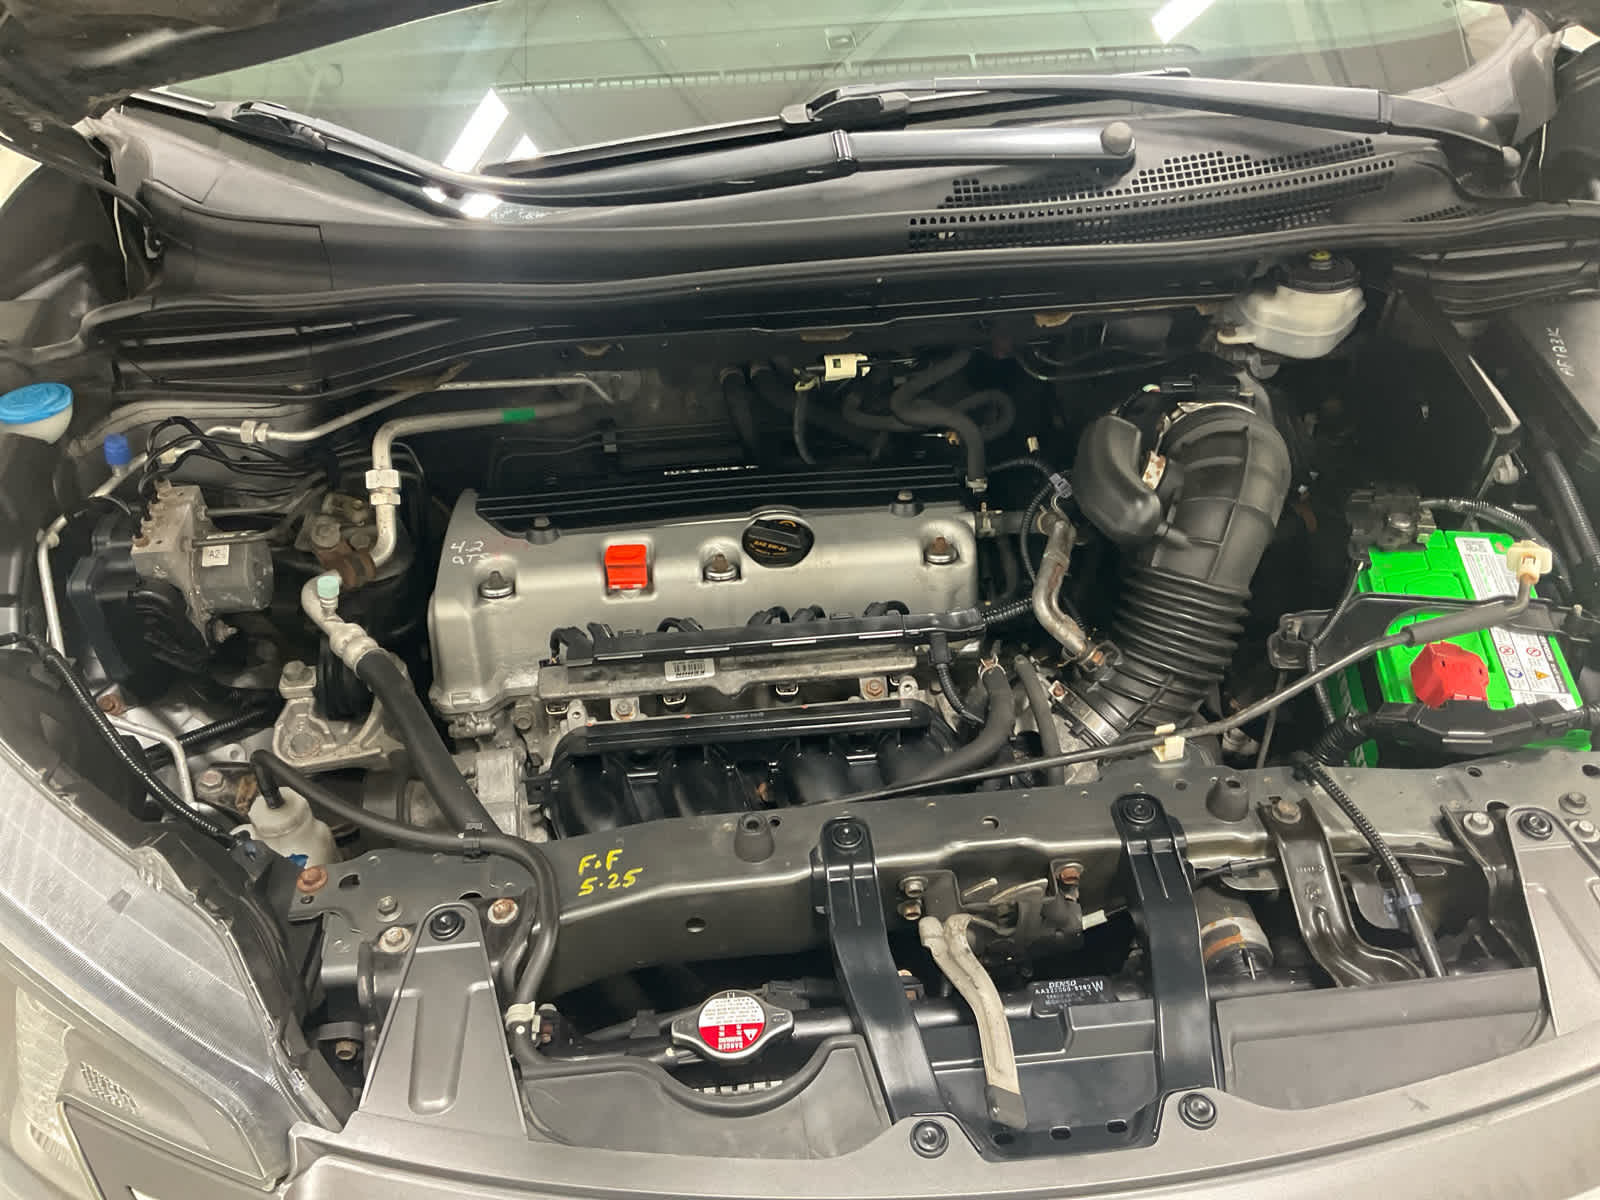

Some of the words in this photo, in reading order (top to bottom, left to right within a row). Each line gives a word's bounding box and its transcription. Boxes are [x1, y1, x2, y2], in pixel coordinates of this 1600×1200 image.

[578, 867, 643, 896] 5.25
[1048, 979, 1077, 989] DENSO
[718, 1042, 743, 1050] DANGER
